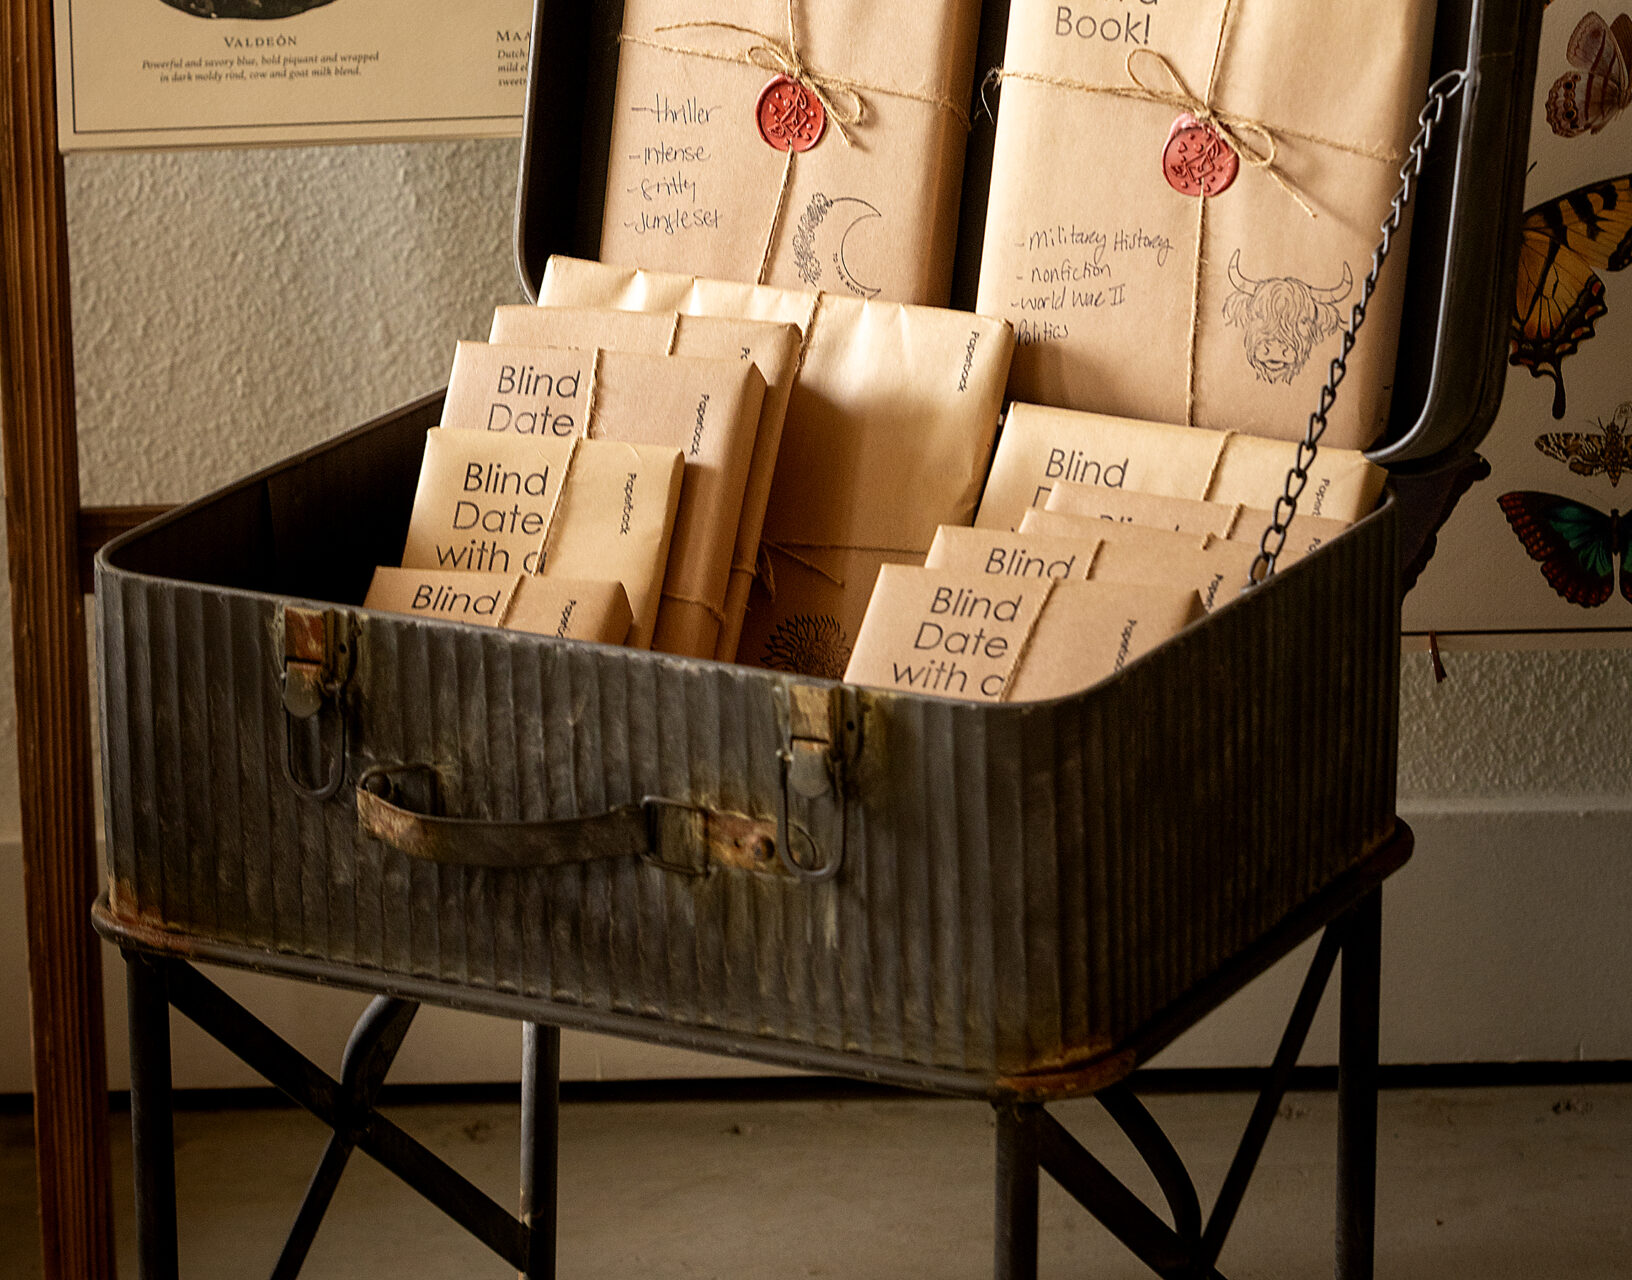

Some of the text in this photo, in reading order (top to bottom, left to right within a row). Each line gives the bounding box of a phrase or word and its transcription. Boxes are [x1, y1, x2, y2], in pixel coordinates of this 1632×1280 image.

[1055, 6, 1151, 45] Book!
[142, 58, 182, 71] Powerful
[185, 58, 202, 68] and
[205, 58, 234, 68] savory
[261, 54, 281, 65] bold
[283, 54, 318, 66] piquant
[321, 53, 338, 63] and
[340, 51, 379, 64] wrapped
[160, 73, 169, 83] in
[172, 72, 192, 82] dark
[195, 71, 222, 83] moldy
[250, 71, 266, 79] cow
[270, 69, 287, 79] and
[289, 70, 309, 80] goat
[311, 66, 332, 76] milk
[335, 66, 362, 76] blend.
[498, 62, 518, 72] mild
[845, 280, 866, 297] MOON
[1109, 283, 1125, 306] II
[957, 331, 980, 392] Paperback
[497, 365, 581, 398] Blind
[487, 403, 575, 437] Date
[690, 393, 710, 456] Paperback
[463, 462, 549, 496] Blind
[1045, 447, 1129, 488] Blind
[453, 501, 544, 535] Date
[620, 472, 637, 536] Paperback
[436, 539, 510, 573] with
[985, 547, 1075, 579] Blind
[411, 584, 501, 615] Blind
[930, 586, 1022, 623] Blind
[914, 622, 1008, 659] Date
[892, 660, 968, 693] with
